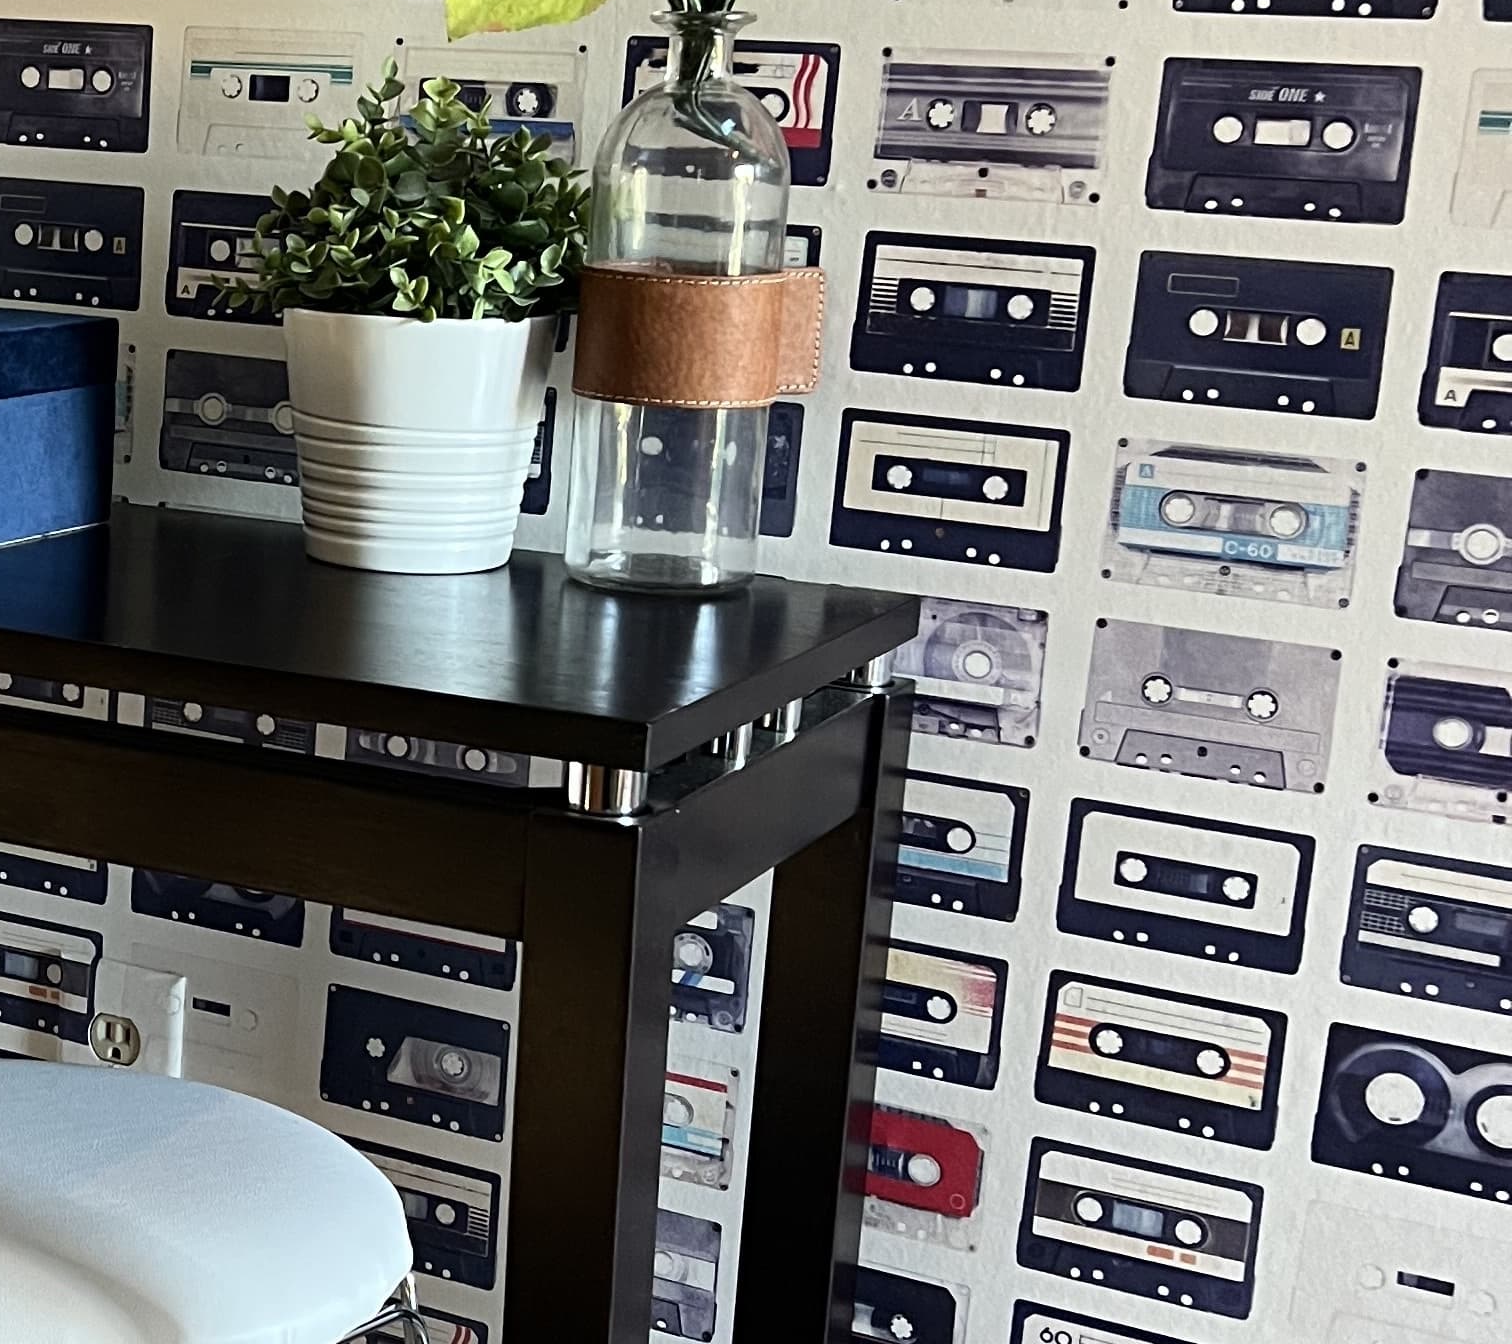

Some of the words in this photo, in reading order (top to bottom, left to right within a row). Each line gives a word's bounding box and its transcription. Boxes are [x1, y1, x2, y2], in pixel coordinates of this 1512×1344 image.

[43, 44, 59, 55] SIDE
[62, 42, 81, 54] ONE
[1248, 87, 1278, 102] SIDE
[1278, 87, 1308, 102] ONE
[897, 97, 922, 121] A
[181, 284, 191, 296] A
[1444, 389, 1457, 402] A
[1224, 540, 1273, 560] C-60
